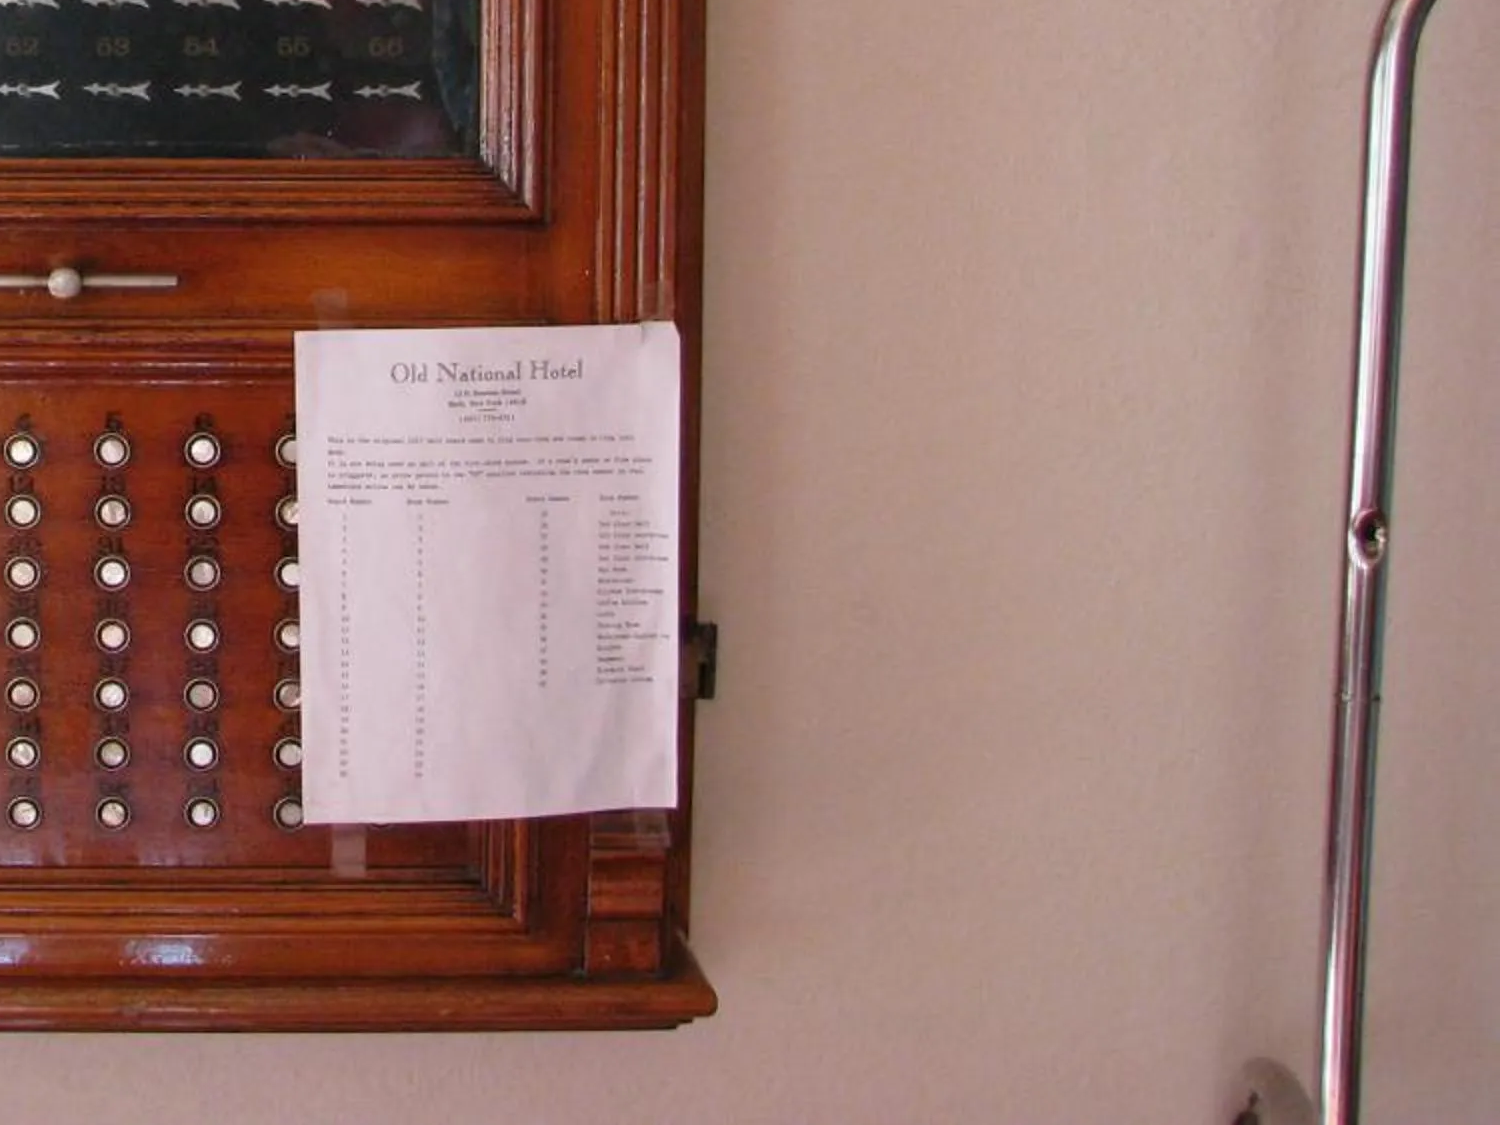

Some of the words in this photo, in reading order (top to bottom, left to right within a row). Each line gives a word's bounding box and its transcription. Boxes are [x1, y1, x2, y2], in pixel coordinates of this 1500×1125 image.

[389, 361, 428, 386] Old
[436, 360, 522, 384] National
[530, 358, 583, 382] Hotel
